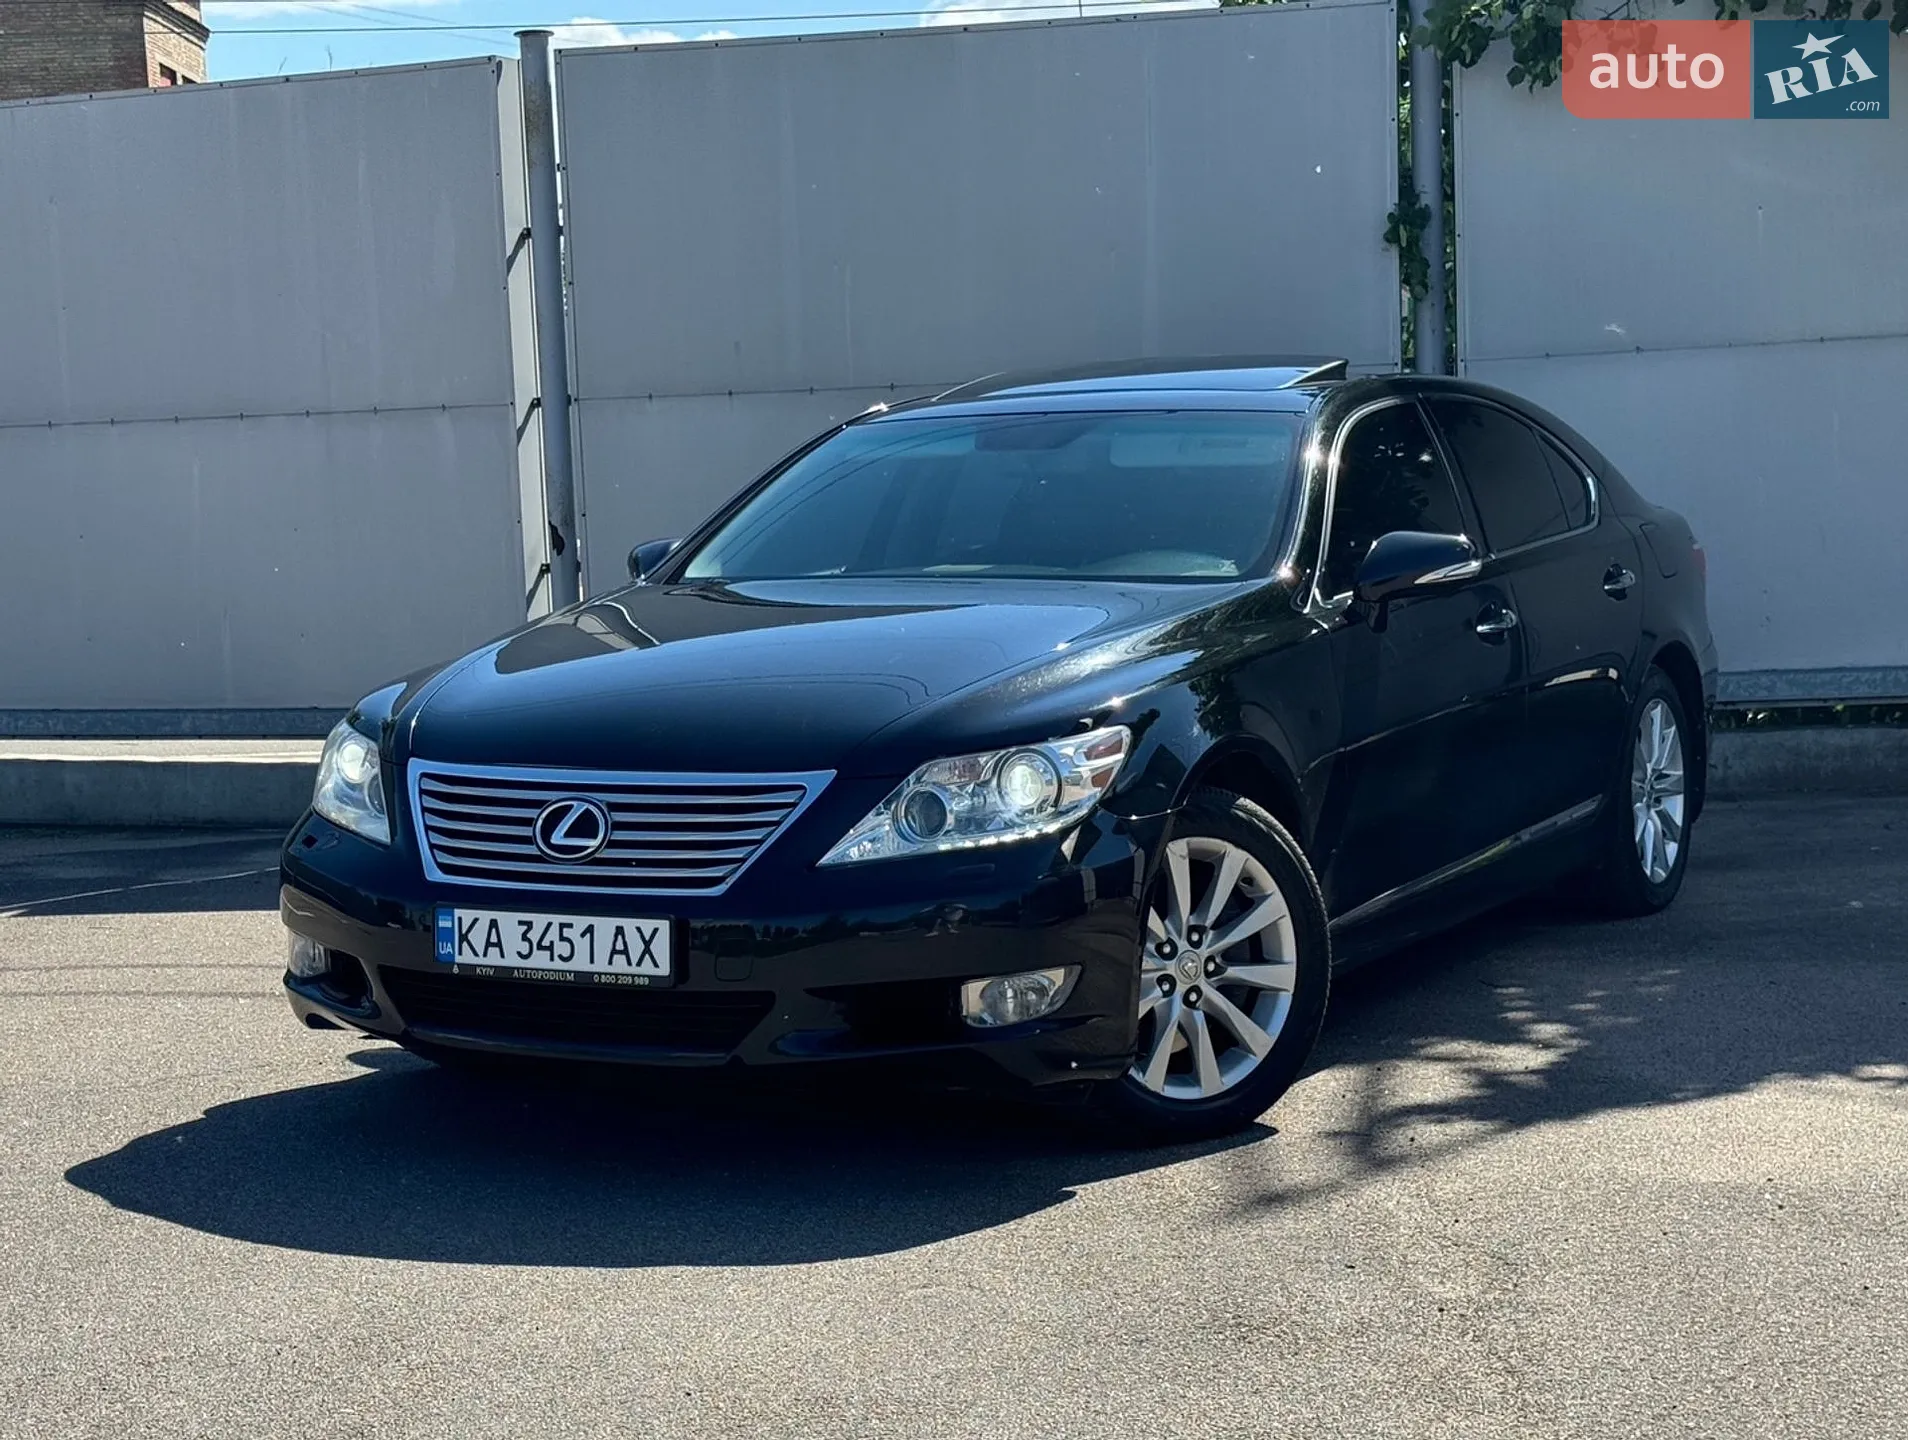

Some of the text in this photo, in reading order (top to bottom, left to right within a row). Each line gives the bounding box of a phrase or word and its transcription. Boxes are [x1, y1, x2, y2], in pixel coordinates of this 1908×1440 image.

[439, 942, 454, 955] UA
[457, 915, 660, 969] KA 3451 AX
[475, 966, 495, 976] KYIV
[512, 969, 575, 981] AUTOPODIUM
[600, 974, 616, 984] 800
